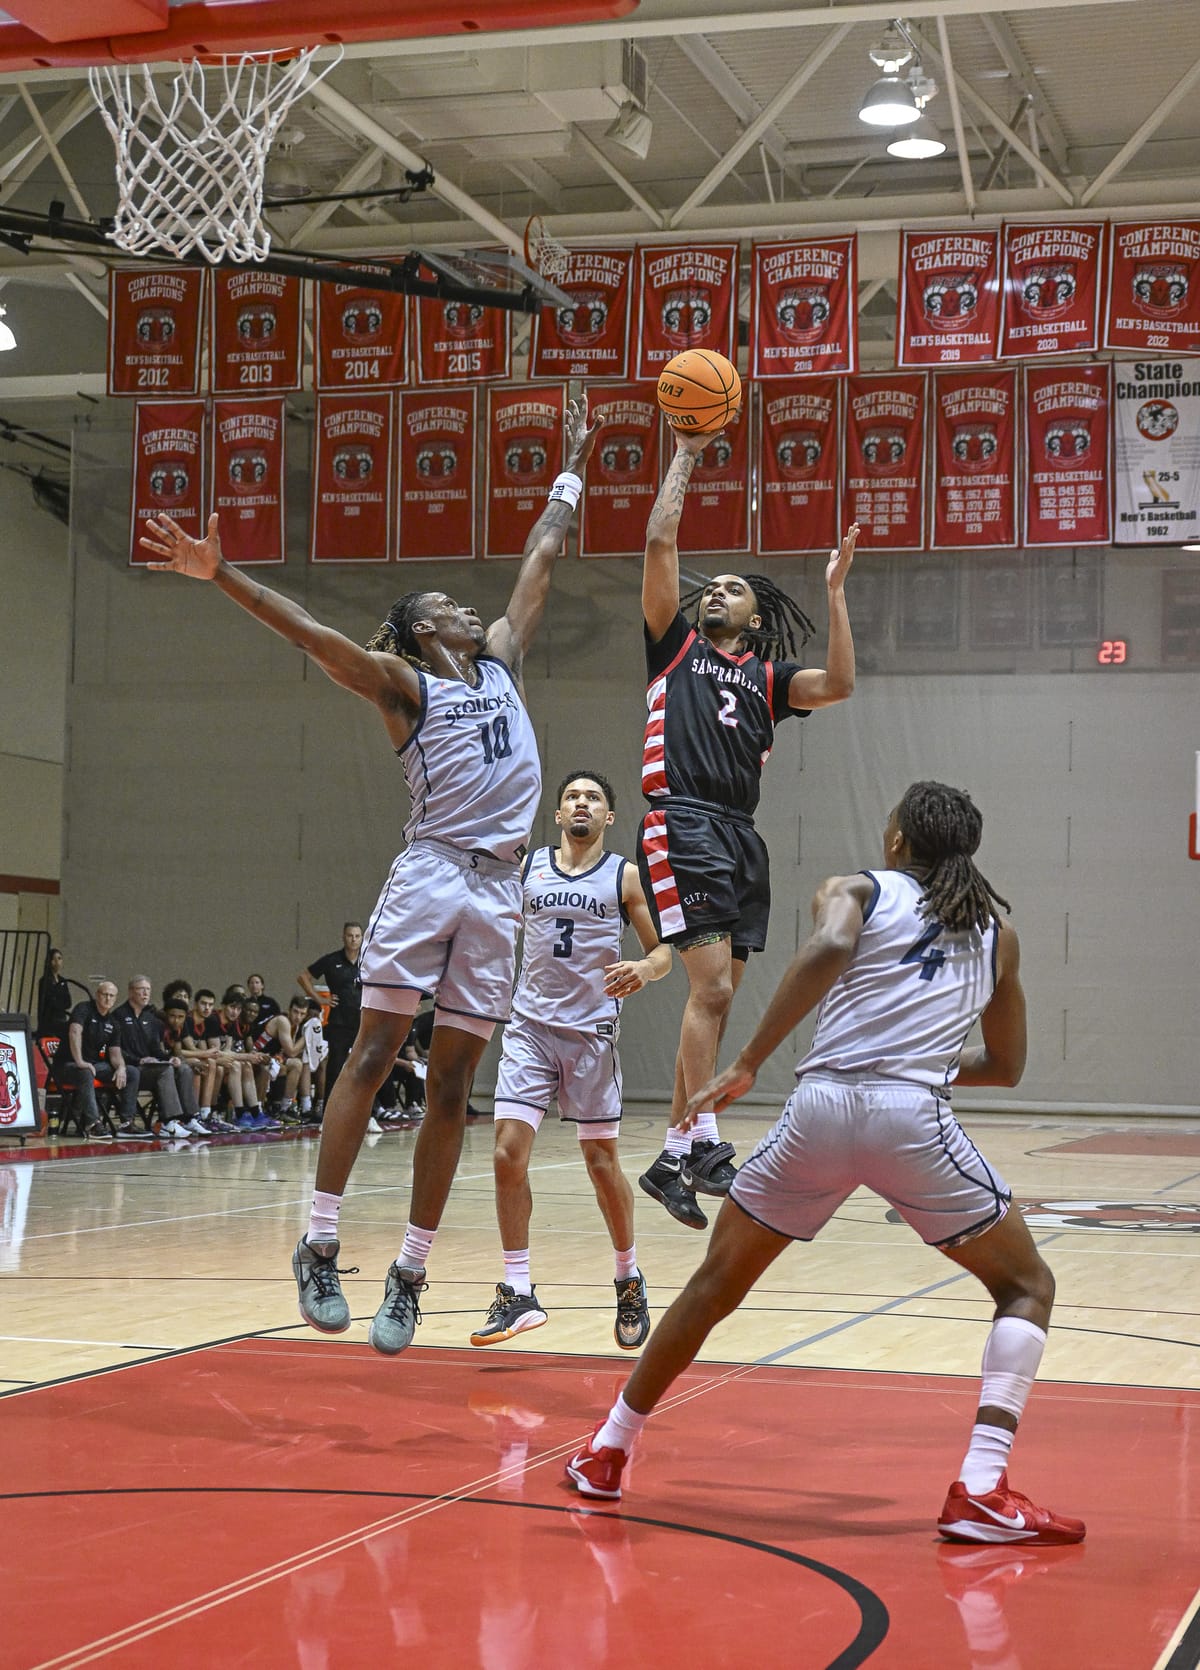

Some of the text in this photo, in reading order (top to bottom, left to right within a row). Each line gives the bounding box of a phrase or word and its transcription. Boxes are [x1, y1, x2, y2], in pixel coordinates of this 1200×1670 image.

[1011, 229, 1095, 252] CONFERENCE
[1014, 243, 1089, 265] CHAMPIONS
[1123, 241, 1200, 260] CHAMPIONS
[553, 254, 625, 275] NFERENCE
[649, 252, 728, 276] CONFERENCE
[763, 248, 844, 272] CONFERENCE
[128, 274, 187, 292] CONFERENCE
[227, 271, 287, 291] CONFERENCE
[653, 266, 722, 288] CHAMPIONS
[768, 263, 839, 285] CHAMPIONS
[131, 286, 184, 302] CHAMPIONS
[231, 282, 283, 300] CHAMPIONS
[1009, 320, 1087, 339] MEN'S BASKETBALL
[1116, 318, 1200, 333] MEN'S BASKETBALL
[454, 339, 494, 350] BASKETBALL
[910, 332, 992, 347] MEN'S BASKETBALL
[1037, 338, 1058, 350] 2020
[1147, 335, 1169, 347] 2022
[246, 350, 286, 362] BASKETBALL
[351, 346, 393, 358] BASKETBALL
[542, 348, 618, 359] MEN'S BASKETBALL
[648, 350, 672, 361] MEN'S
[764, 342, 842, 358] MEN'S BASKETBALL
[940, 349, 960, 361] 2019
[144, 354, 183, 365] BASKETBALL
[448, 353, 481, 373] 2015
[138, 368, 169, 386] 2012
[240, 365, 272, 383] 2013
[345, 360, 379, 379] 2014
[1134, 363, 1183, 381] State
[941, 387, 1008, 407] CONFERENCE
[1033, 382, 1102, 403] CONFERENCE
[1117, 380, 1200, 400] Champion
[767, 395, 832, 414] CONFERENCE
[852, 390, 918, 409] CONFERENCE
[1037, 396, 1099, 414] CHAMPIONS
[406, 406, 468, 425] CONFERENCE
[496, 402, 558, 421] CONFERENCE
[592, 400, 655, 419] CONFERENCE
[770, 407, 829, 425] CHAMPIONS
[856, 403, 915, 421] CHAMPIONS
[945, 400, 1005, 418] CHAMPIONS
[219, 414, 278, 433] CONFERENCE
[324, 409, 384, 428] CONFERENCE
[410, 419, 465, 436] CHAMPIONS
[500, 414, 554, 432] CHAMPIONS
[602, 412, 651, 428] HAMPIONS
[142, 428, 199, 445] CONFERENCE
[222, 426, 275, 443] CHAMPIONS
[327, 422, 381, 439] CHAMPIONS
[144, 440, 196, 456] CHAMPIONS
[849, 477, 917, 489] MEN'S BASKETBALL
[941, 474, 1009, 486] MEN'S BASKETBALL
[1033, 470, 1103, 483] MEN'S BASKETBALL
[1158, 471, 1180, 482] 25-5
[405, 489, 468, 500] MEN'S BASKETBALL
[494, 486, 549, 498] MEN'S BASKETBA
[590, 484, 654, 496] MEN'S BASKETBALL
[698, 481, 744, 492] BASKETBALL
[766, 480, 833, 492] MEN'S BASKETBALL
[218, 494, 278, 506] MEN'S BASKETBALL
[322, 492, 383, 503] MEN'S BASKETBALL
[1121, 510, 1197, 522] Men's Basketball
[1147, 526, 1169, 536] 1962
[1098, 640, 1127, 664] 23
[718, 689, 739, 729] 2
[476, 716, 512, 765] 10
[530, 892, 607, 920] SEQUOIAS
[683, 892, 709, 906] CITY
[553, 918, 575, 959] 3
[899, 922, 947, 981] 4
